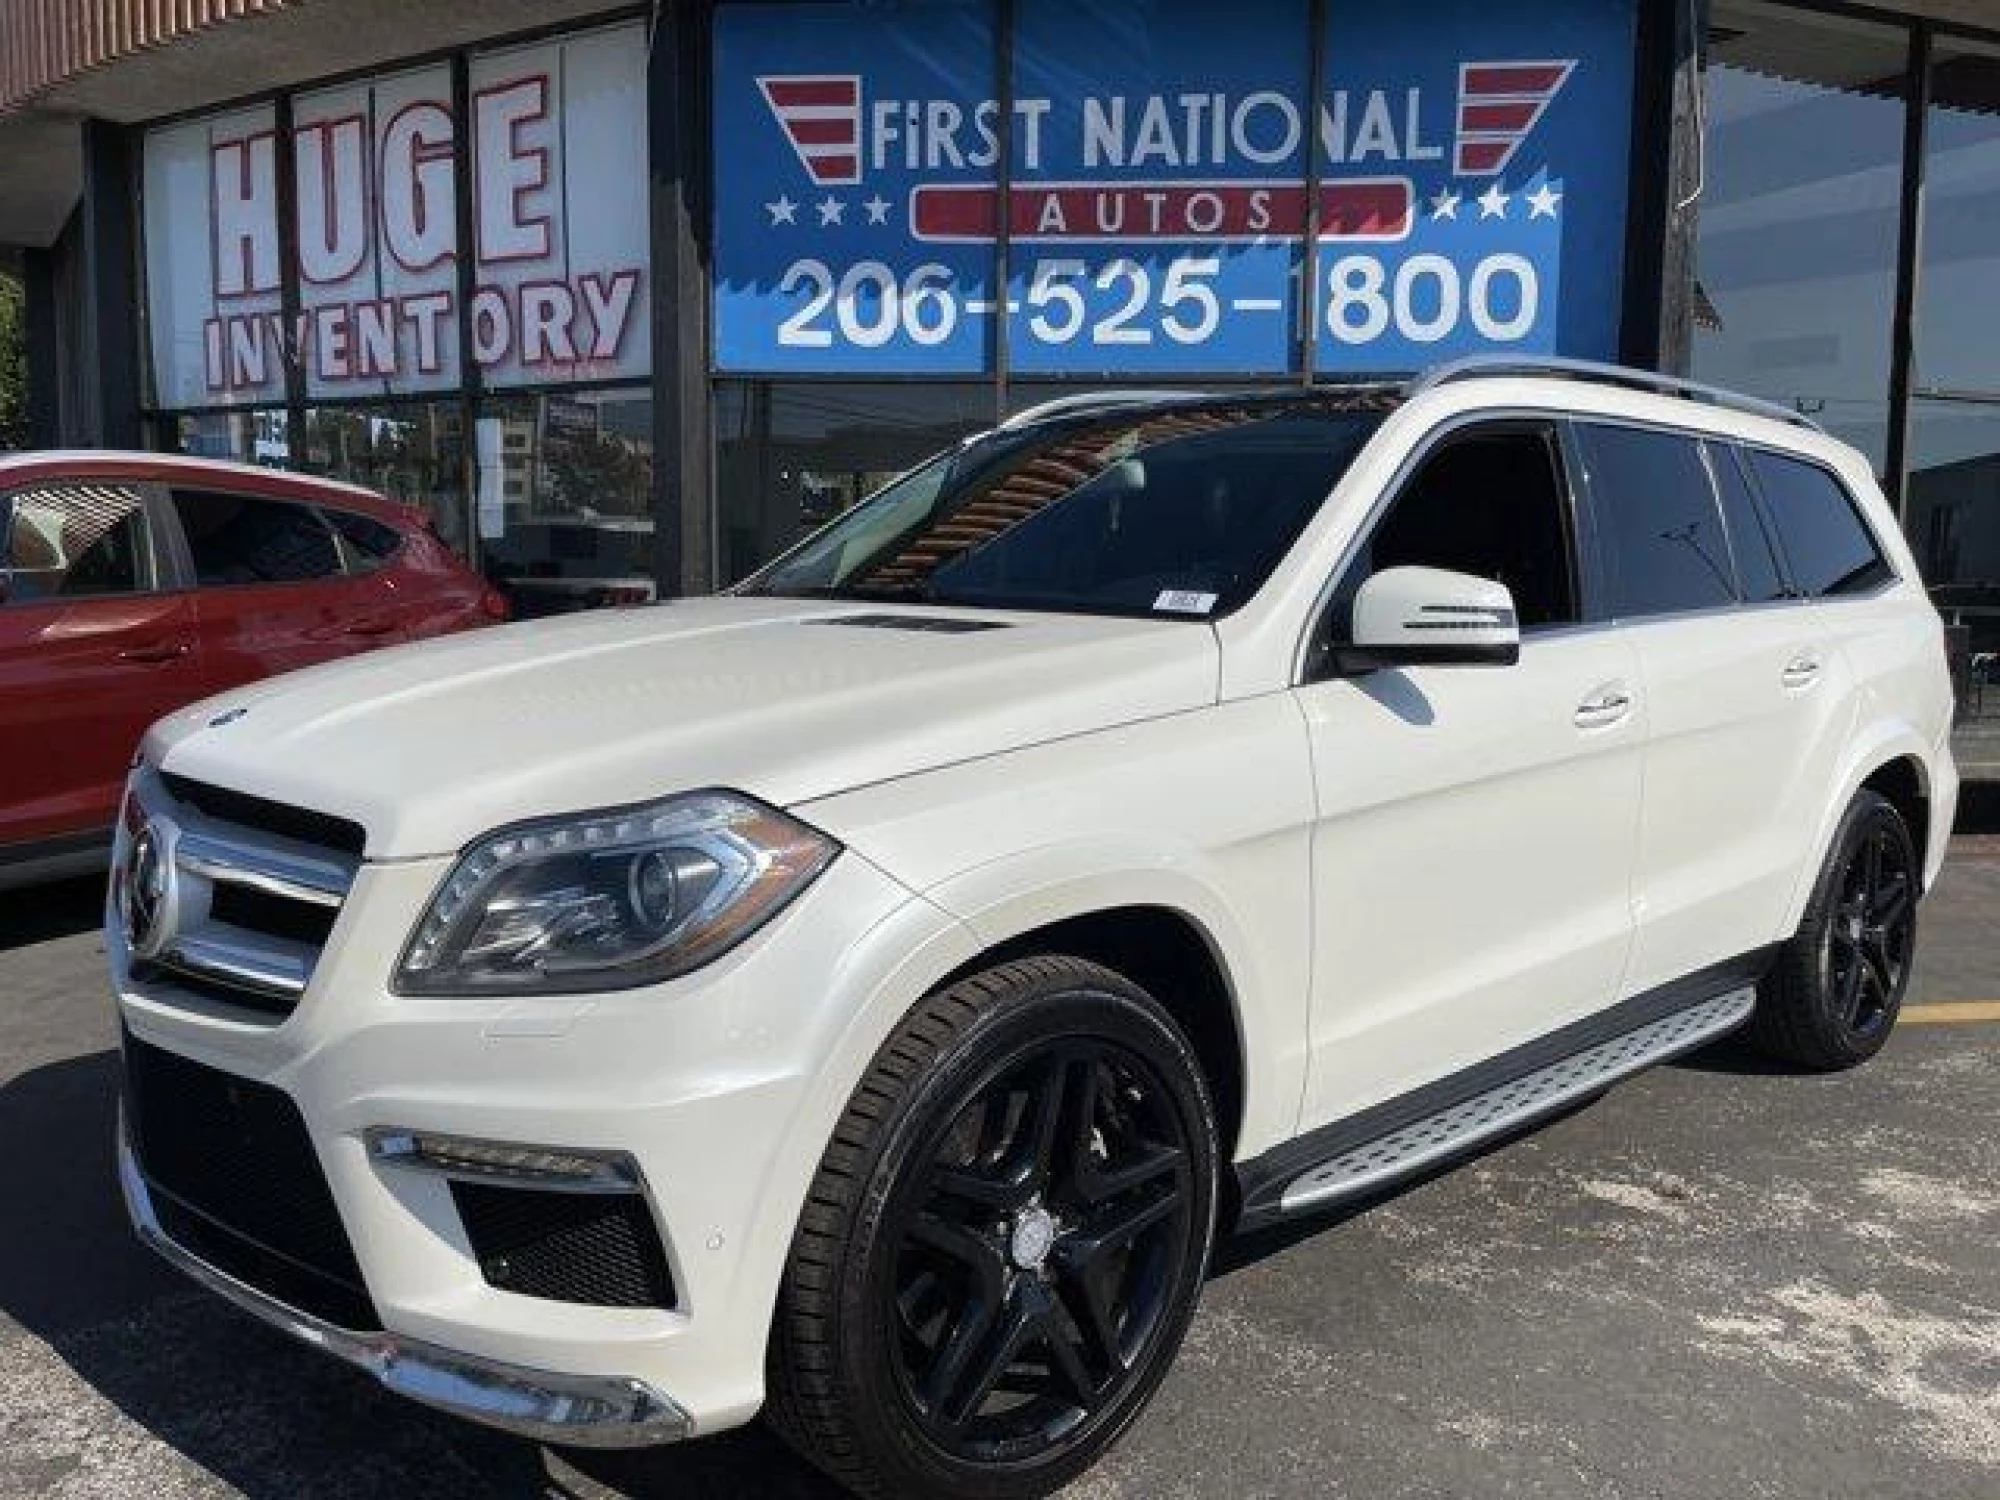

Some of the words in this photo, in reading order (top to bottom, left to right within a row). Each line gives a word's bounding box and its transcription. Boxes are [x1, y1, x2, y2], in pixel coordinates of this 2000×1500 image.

[1083, 87, 1444, 167] NATIONAL
[209, 74, 551, 299] HUGE
[1035, 188, 1272, 233] AUTOS
[203, 269, 640, 391] INVENTORY
